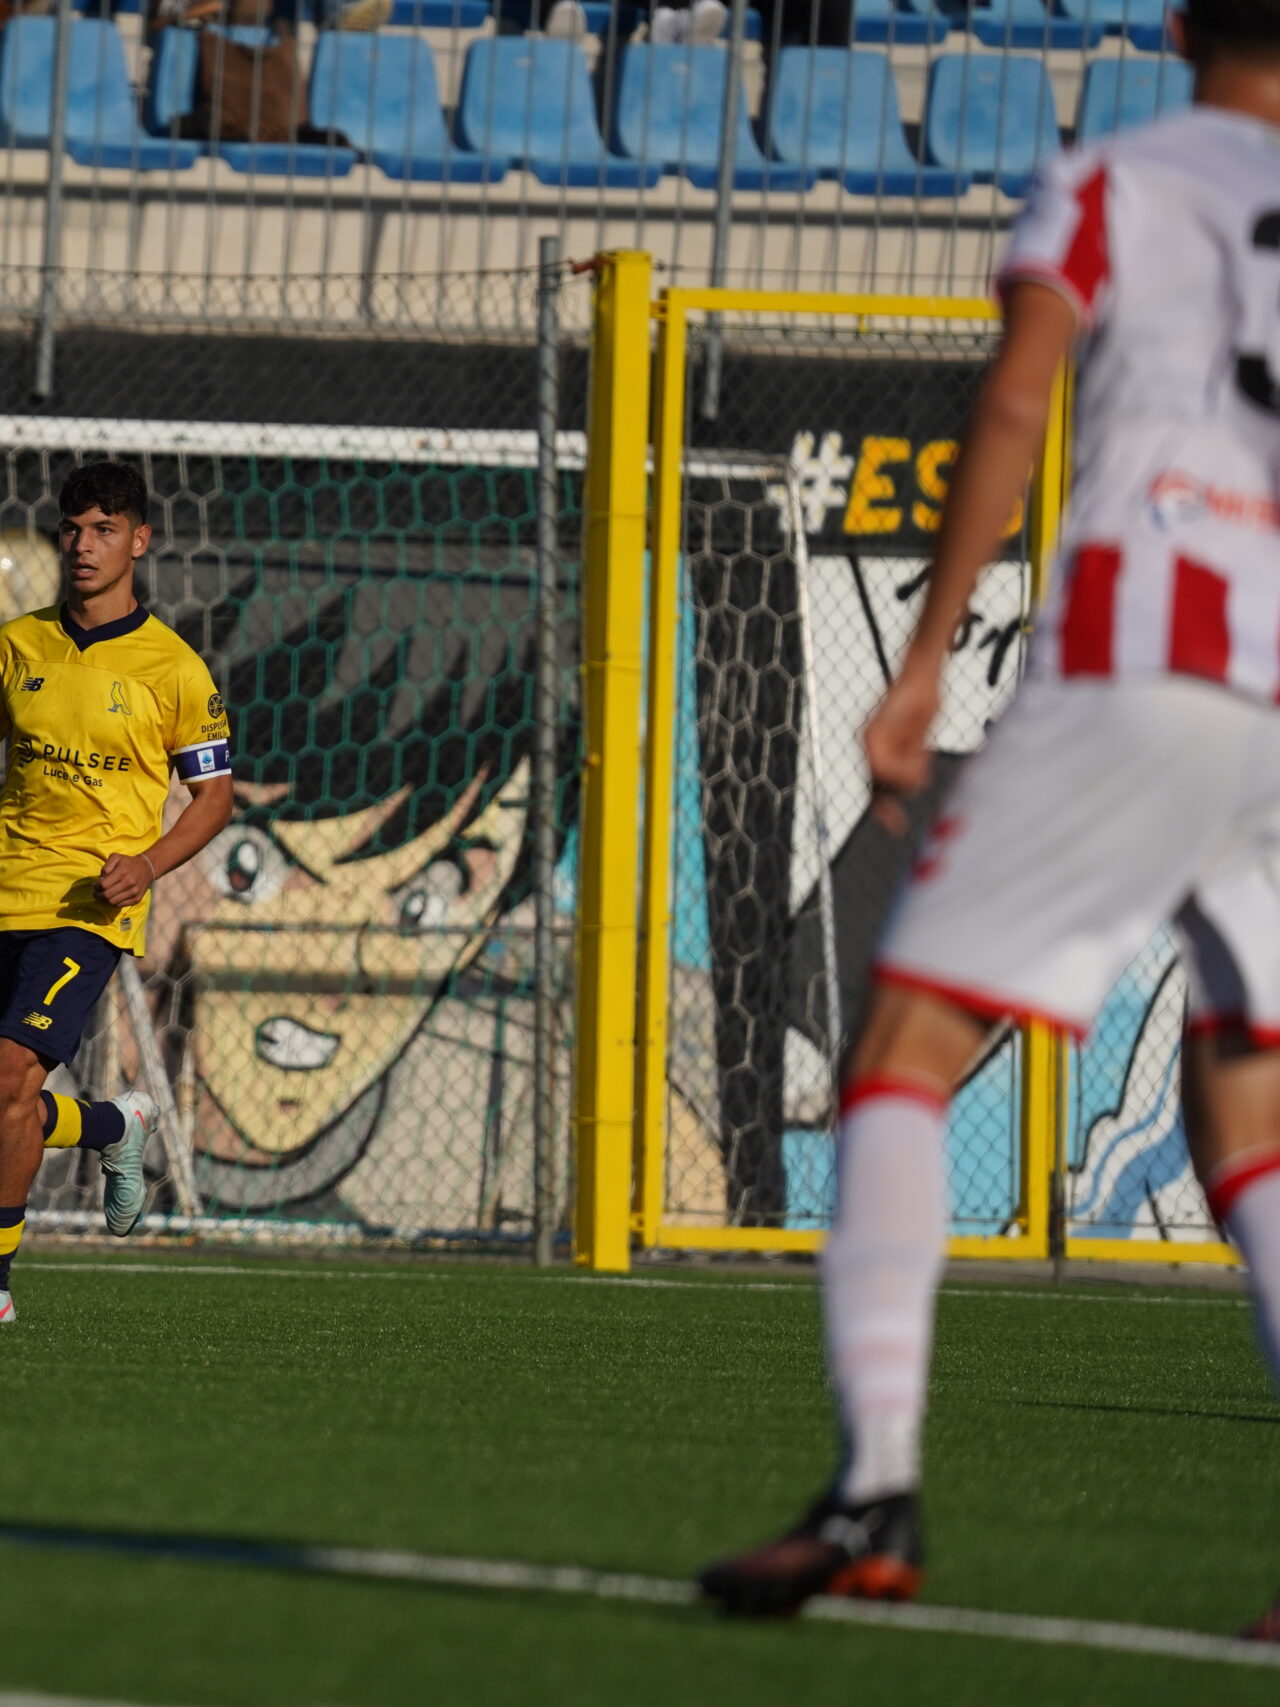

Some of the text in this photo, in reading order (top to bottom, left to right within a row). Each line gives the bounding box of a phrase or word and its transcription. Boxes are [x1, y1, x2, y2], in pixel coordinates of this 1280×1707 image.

[43, 743, 132, 772] PULSEE
[43, 765, 103, 788] Luce e Gas
[43, 956, 81, 1006] 7
